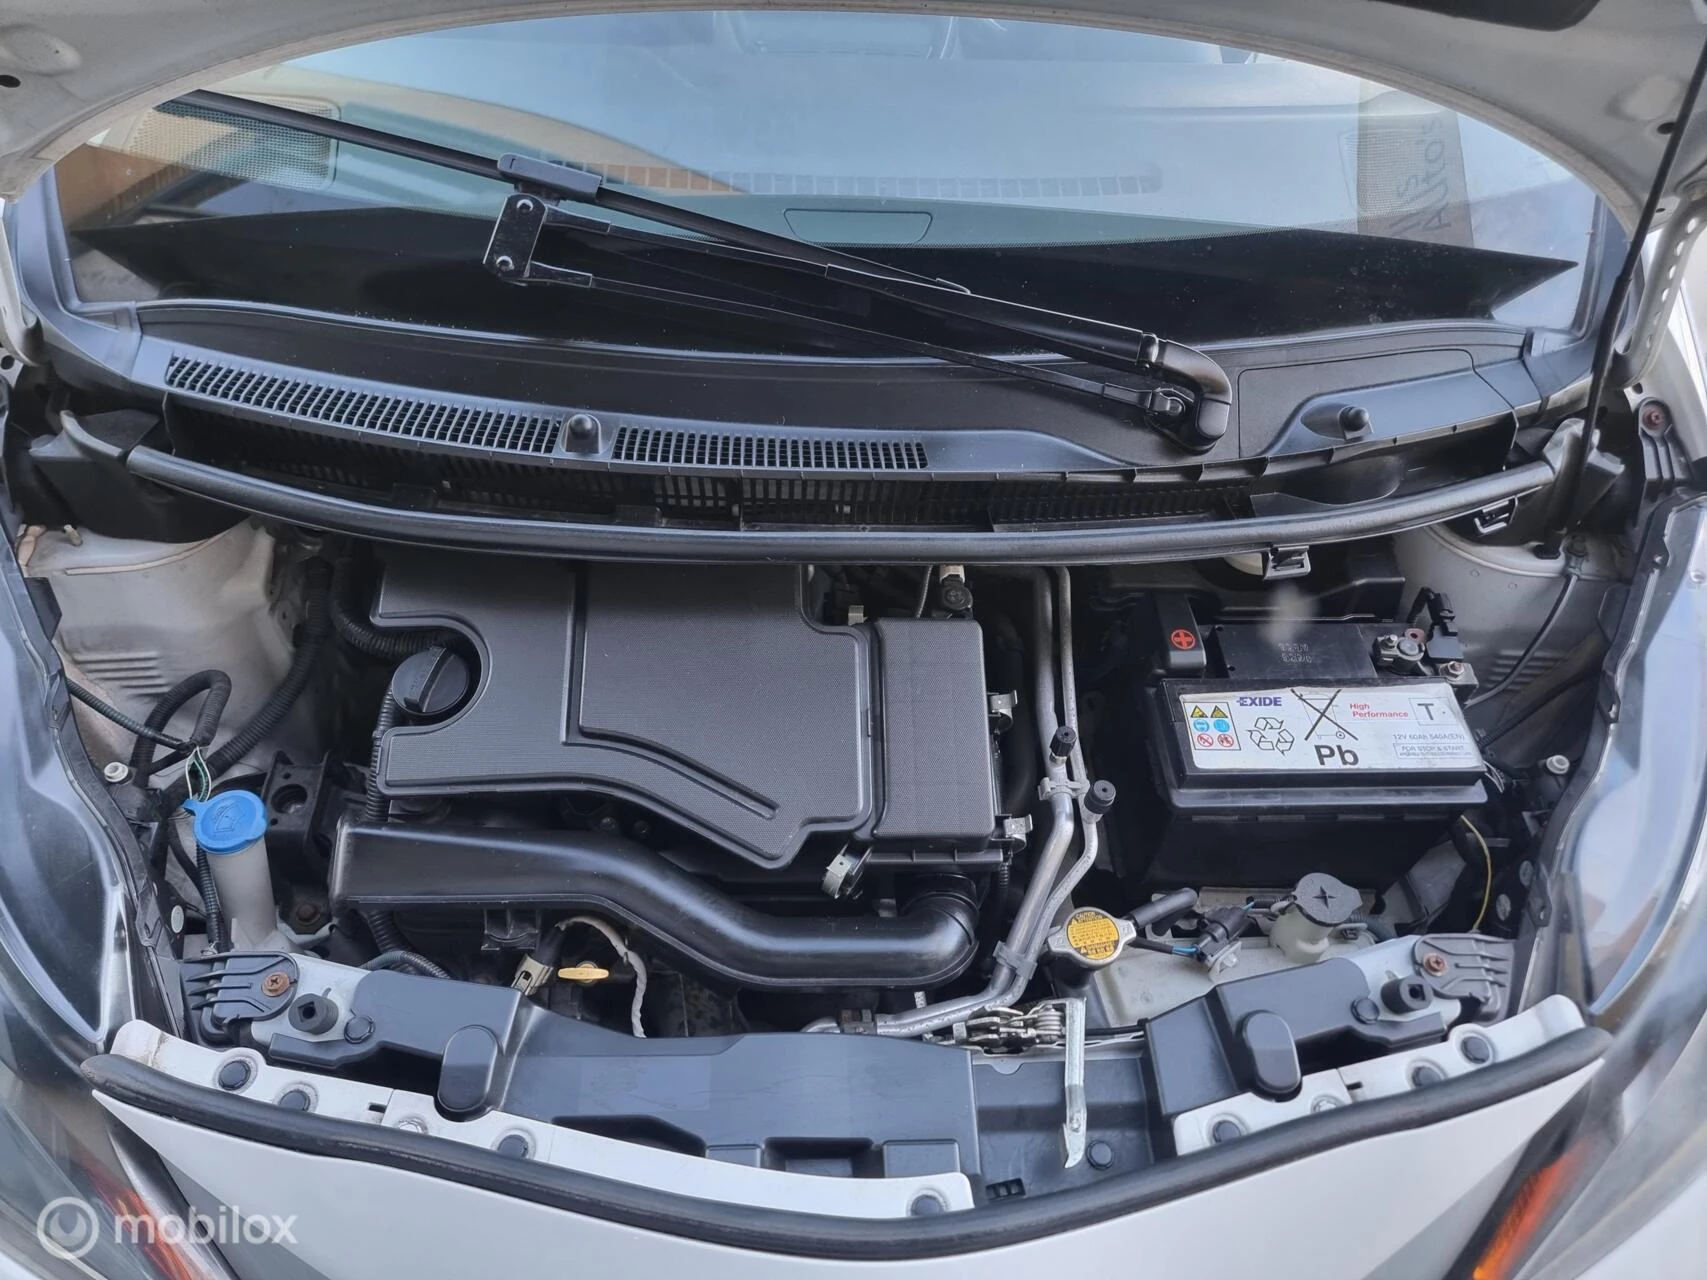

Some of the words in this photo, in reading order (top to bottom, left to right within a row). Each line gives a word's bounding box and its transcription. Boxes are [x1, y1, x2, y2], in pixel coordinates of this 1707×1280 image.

[1238, 697, 1282, 707] EXIDE
[1350, 703, 1370, 711] High
[1352, 711, 1409, 719] Performance
[1417, 703, 1434, 721] T
[1314, 744, 1360, 766] Pb
